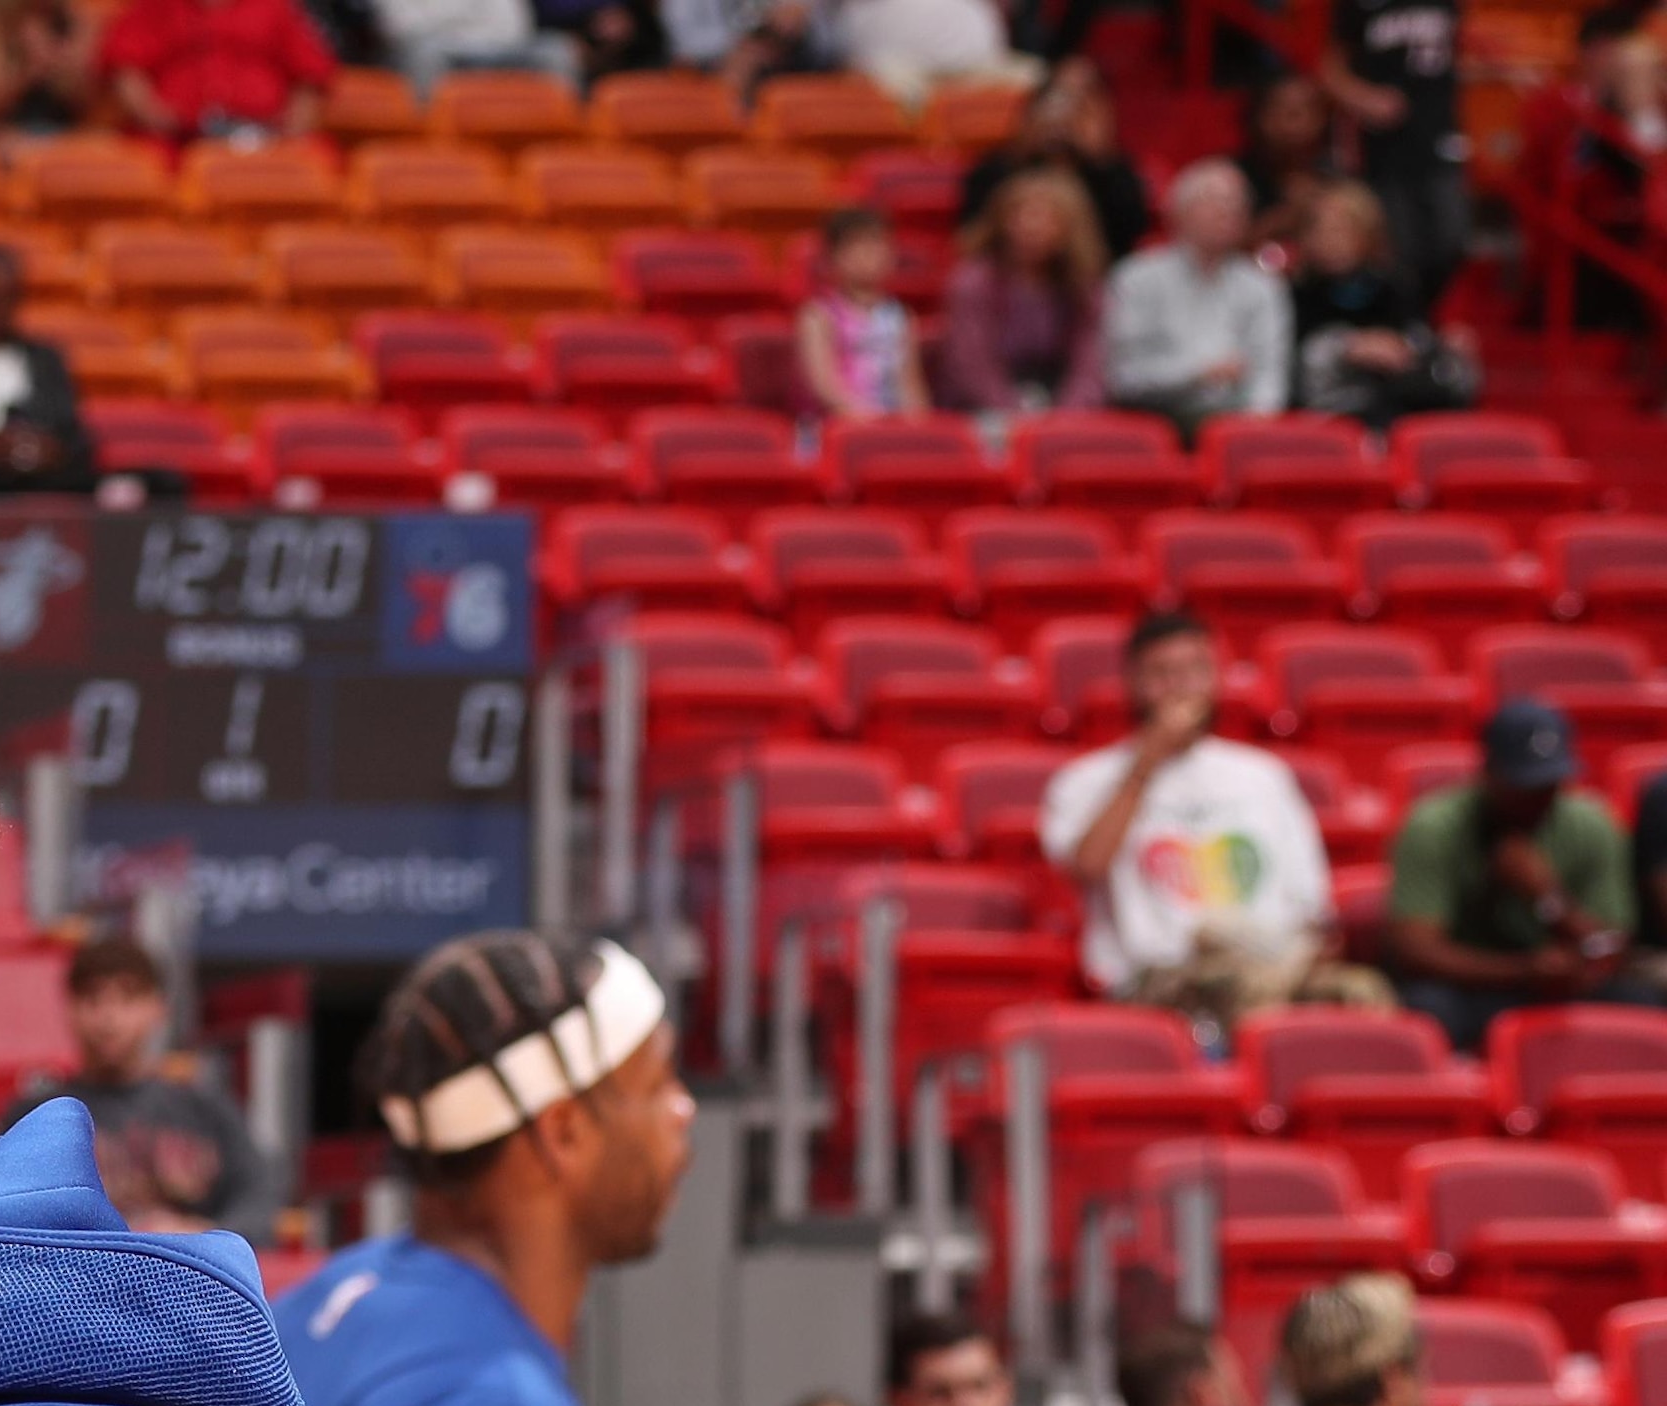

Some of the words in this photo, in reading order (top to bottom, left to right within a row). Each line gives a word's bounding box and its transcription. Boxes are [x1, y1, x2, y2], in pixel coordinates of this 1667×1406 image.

[405, 562, 510, 652] 76
[71, 678, 141, 786] 0
[448, 678, 526, 788] 0
[287, 840, 495, 904] Center
